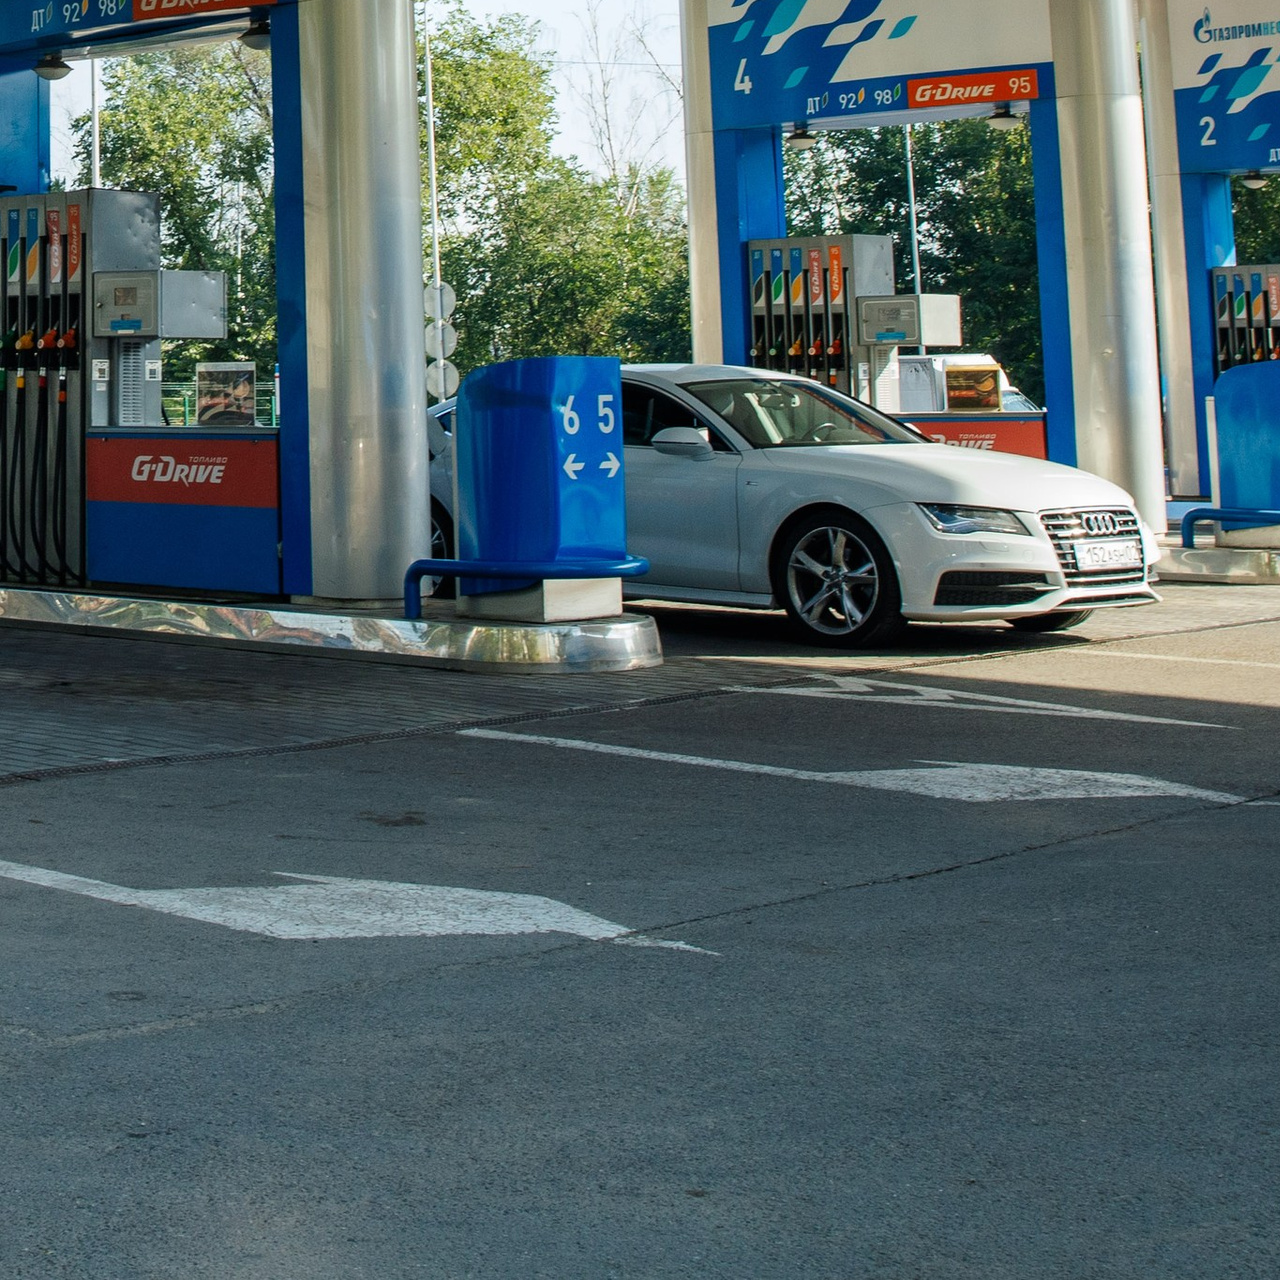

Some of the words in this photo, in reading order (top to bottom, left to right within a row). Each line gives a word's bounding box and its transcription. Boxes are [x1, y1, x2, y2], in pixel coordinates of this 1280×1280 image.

[31, 7, 45, 33] ДТ
[62, 3, 80, 24] 92
[734, 58, 752, 95] 4
[806, 96, 820, 115] ДТ
[838, 93, 857, 109] 92
[874, 89, 893, 105] 98
[1008, 76, 1031, 94] 95
[1199, 116, 1217, 146] 2
[562, 394, 580, 435] 6
[597, 394, 615, 434] 5
